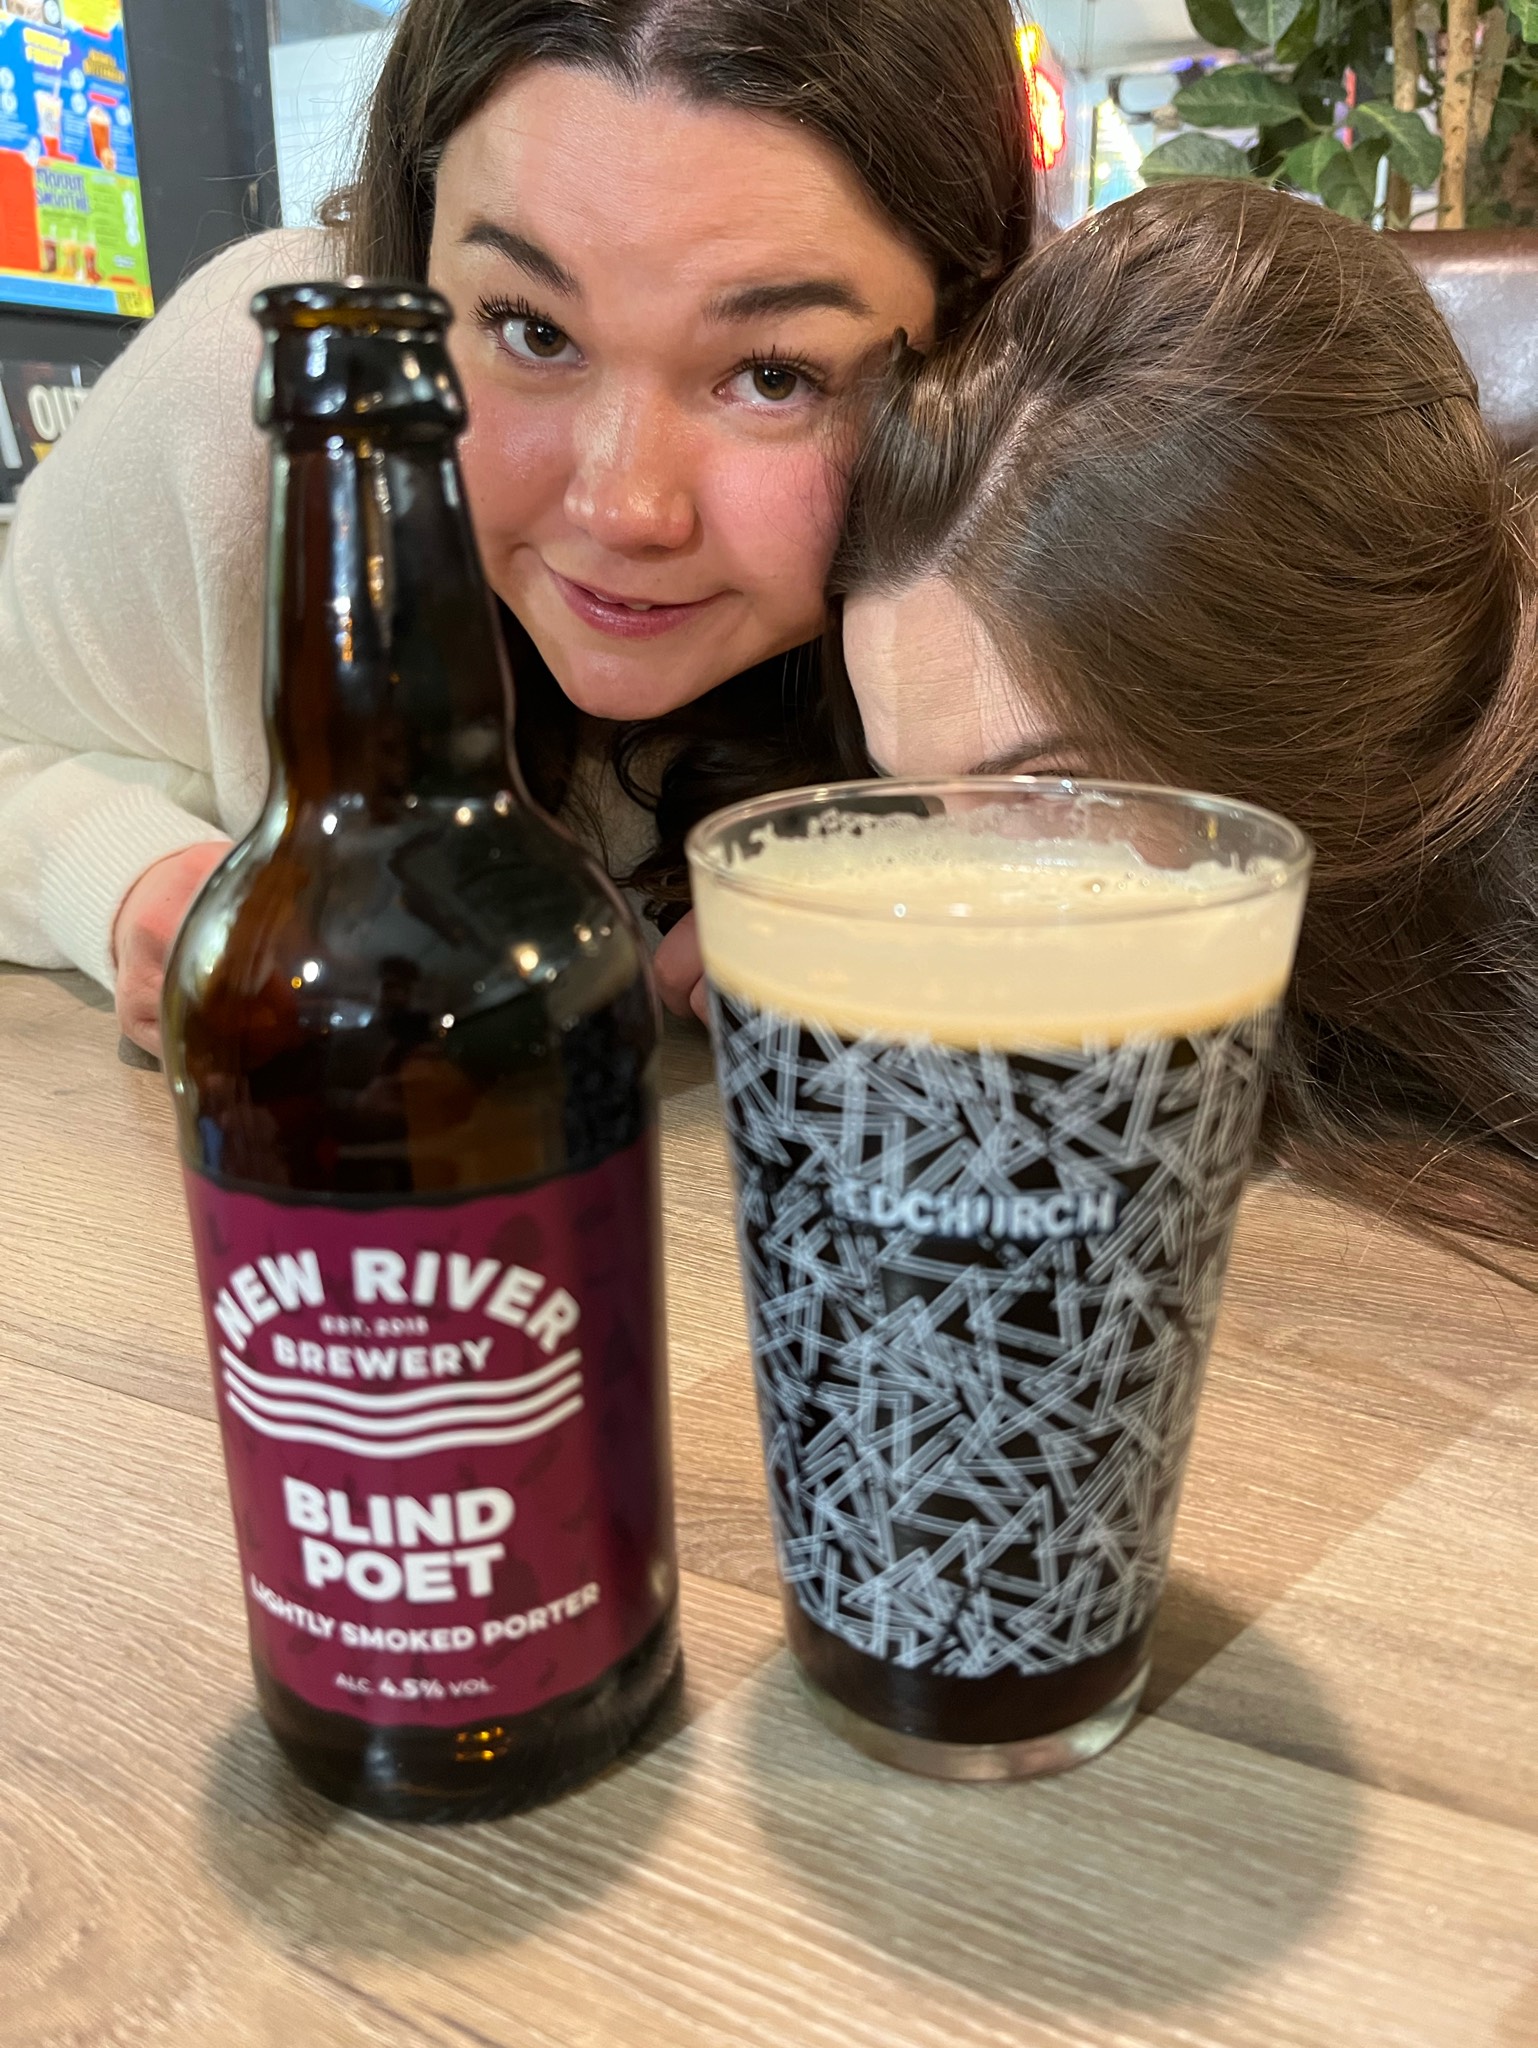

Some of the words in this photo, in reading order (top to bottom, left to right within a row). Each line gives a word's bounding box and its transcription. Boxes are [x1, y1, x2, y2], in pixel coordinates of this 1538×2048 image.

[832, 1180, 1117, 1239] EDCHURCH
[214, 1248, 326, 1350] NEW
[351, 1248, 581, 1353] RIVER
[272, 1333, 494, 1380] BREWERY
[282, 1475, 515, 1547] BLIND
[301, 1536, 506, 1603] POET
[250, 1572, 334, 1639] LIGHTLY
[340, 1622, 475, 1652] SMOKED
[482, 1581, 600, 1646] PORTER
[379, 1676, 447, 1700] 4.5%
